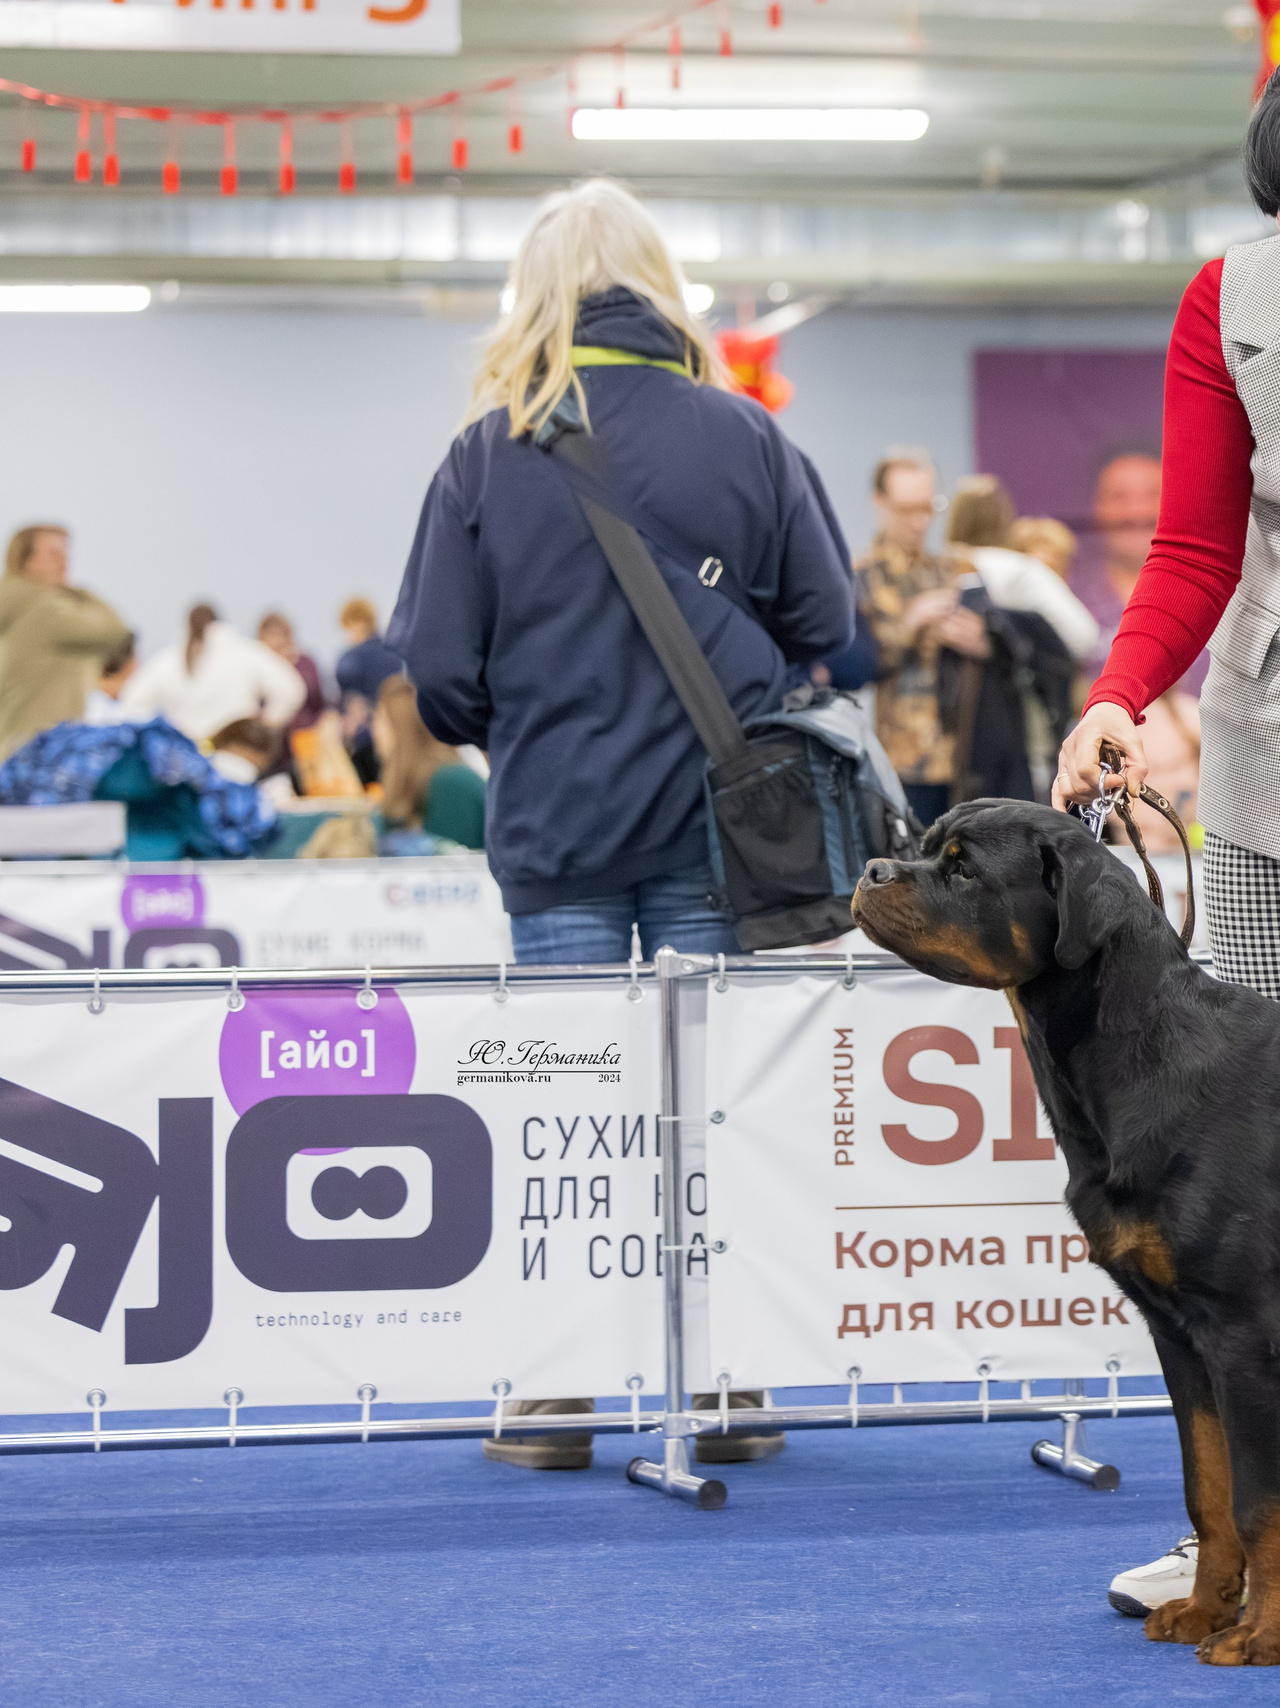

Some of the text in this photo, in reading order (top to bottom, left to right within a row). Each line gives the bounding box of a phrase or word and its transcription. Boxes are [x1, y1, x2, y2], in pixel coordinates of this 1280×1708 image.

[261, 1029, 375, 1078] [айо]
[834, 1027, 854, 1166] PREMIUM
[520, 1175, 610, 1230] ДЛЯ
[522, 1236, 546, 1281] И
[835, 1231, 1090, 1278] Корма пр
[256, 1309, 462, 1328] technology and care
[837, 1296, 1130, 1339] для кошек
